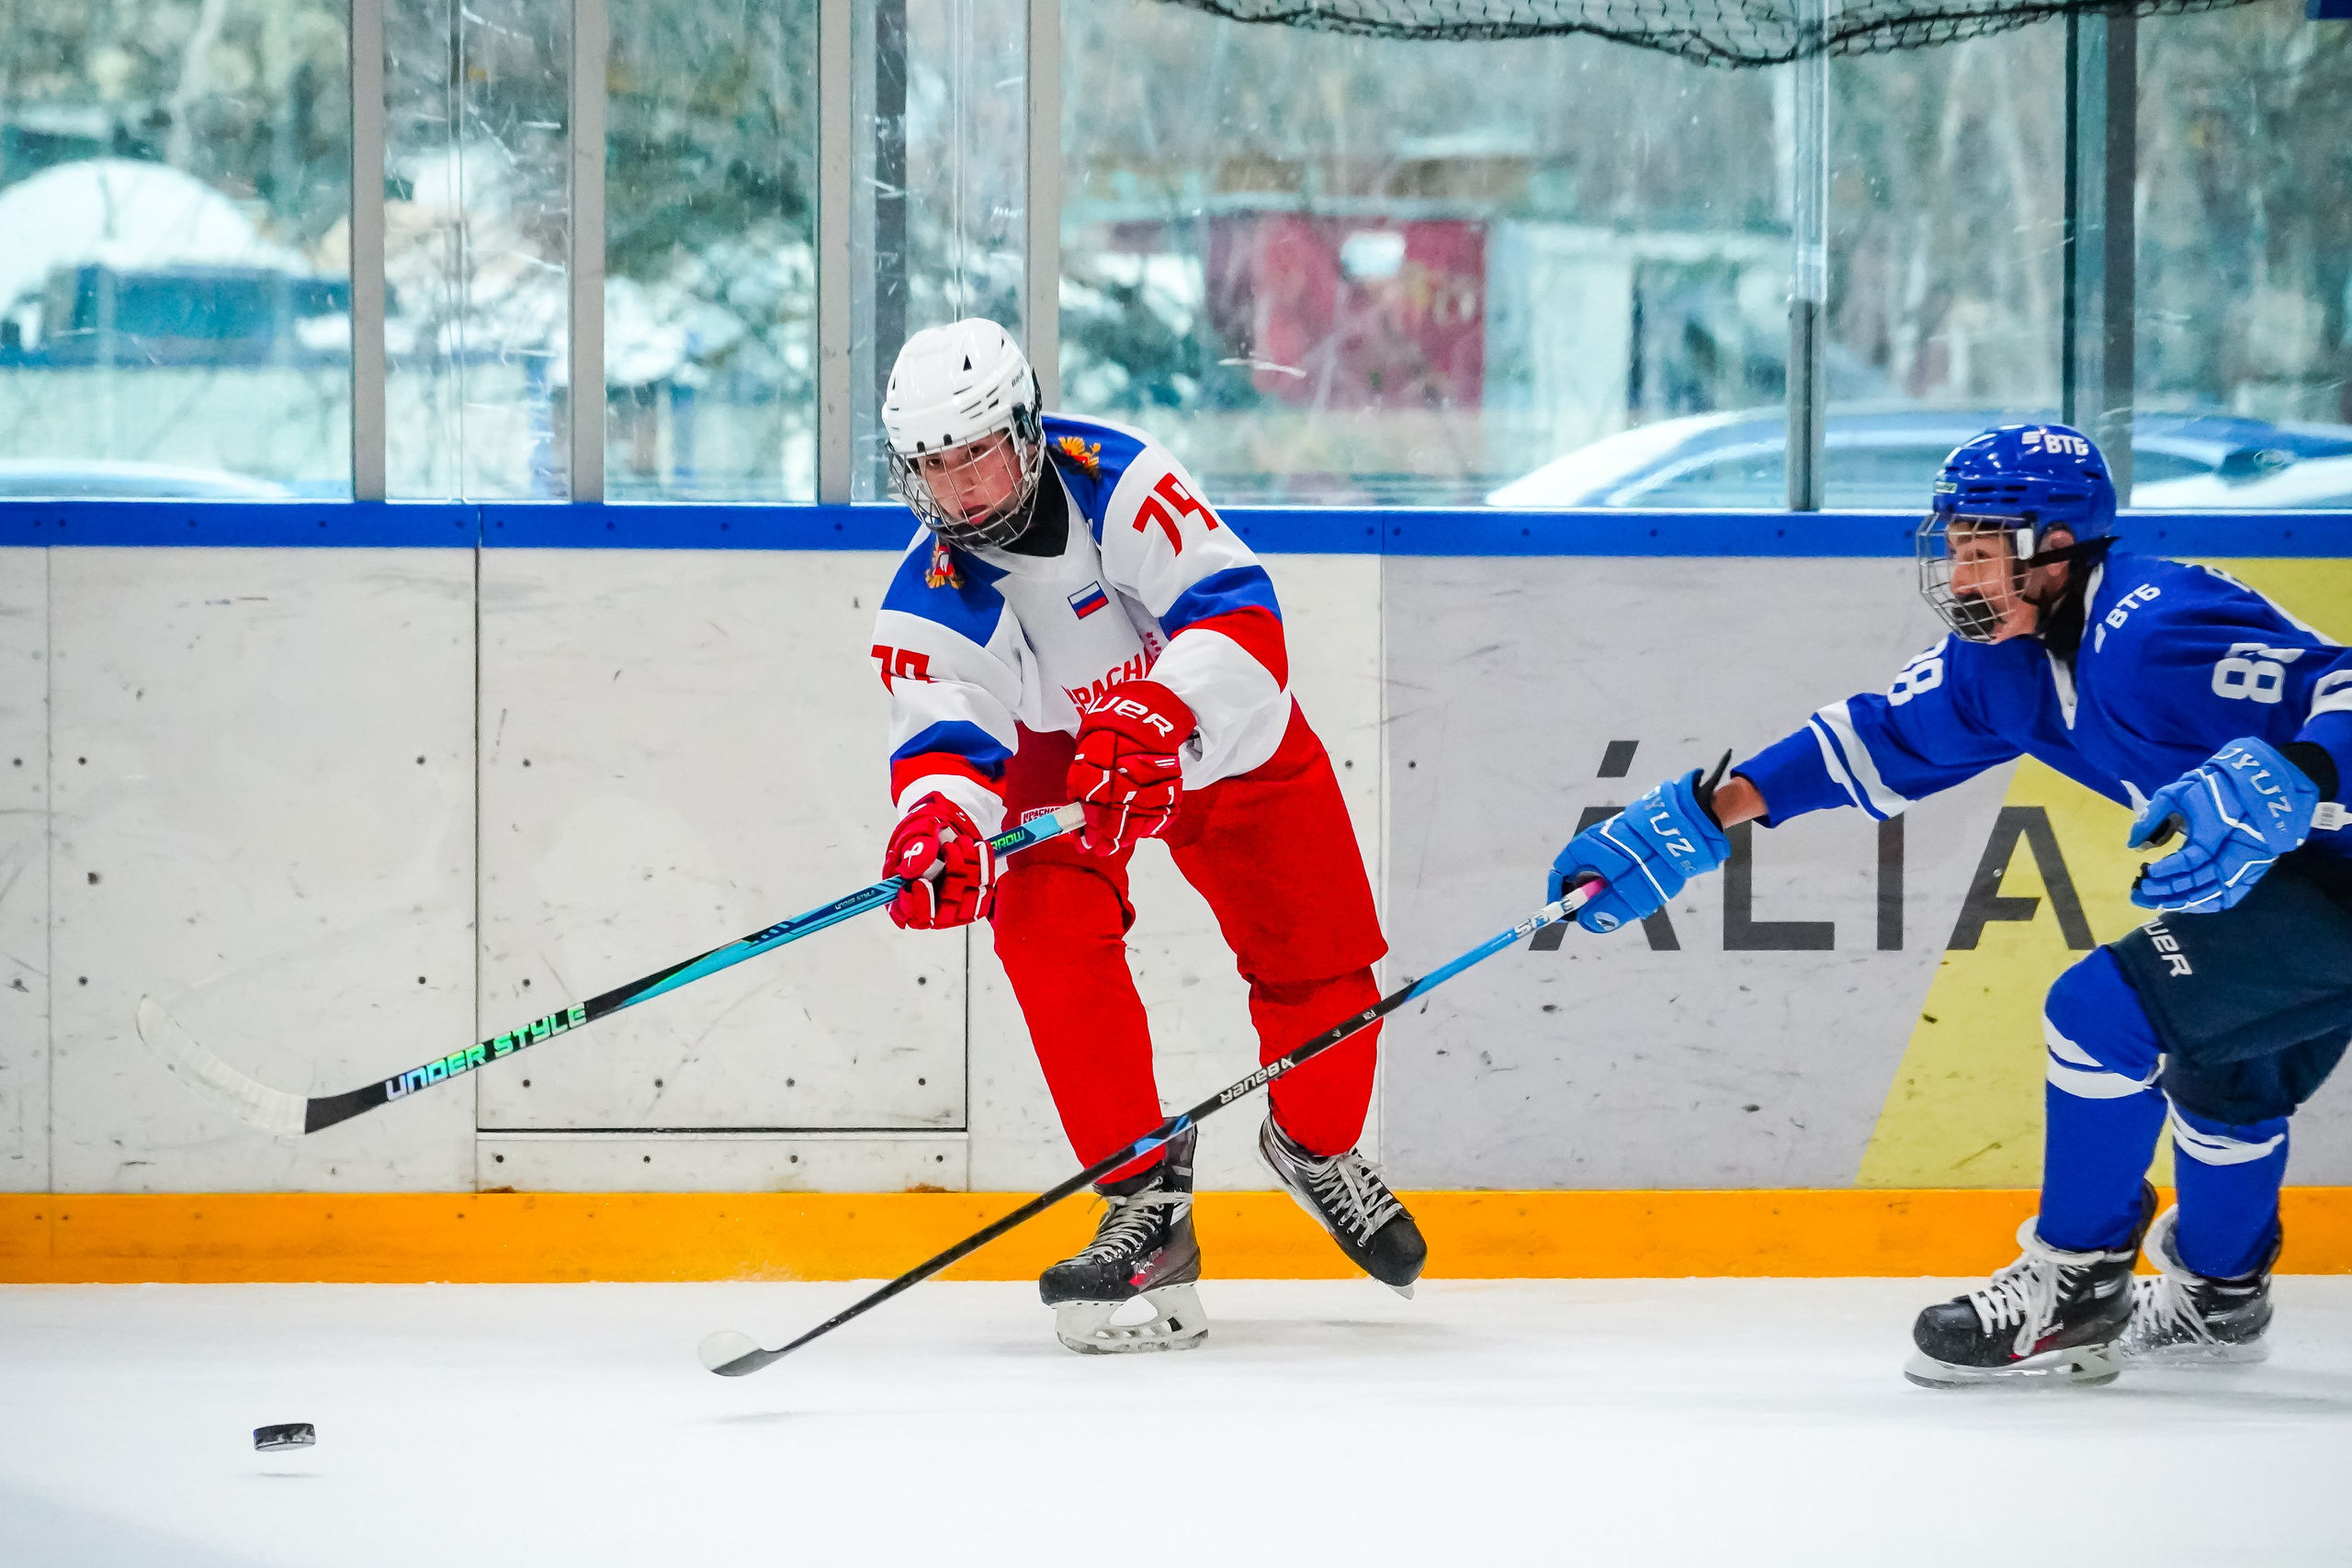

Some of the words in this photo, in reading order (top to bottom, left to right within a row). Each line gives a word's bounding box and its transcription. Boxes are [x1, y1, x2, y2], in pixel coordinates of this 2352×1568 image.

[1132, 472, 1219, 558] 79
[2105, 582, 2161, 629] ВТБ
[1087, 696, 1174, 738] UER
[2142, 917, 2193, 977] UER
[385, 1043, 486, 1102] UNDER
[492, 1002, 587, 1058] STYLE
[1219, 1061, 1280, 1104] BAUER
